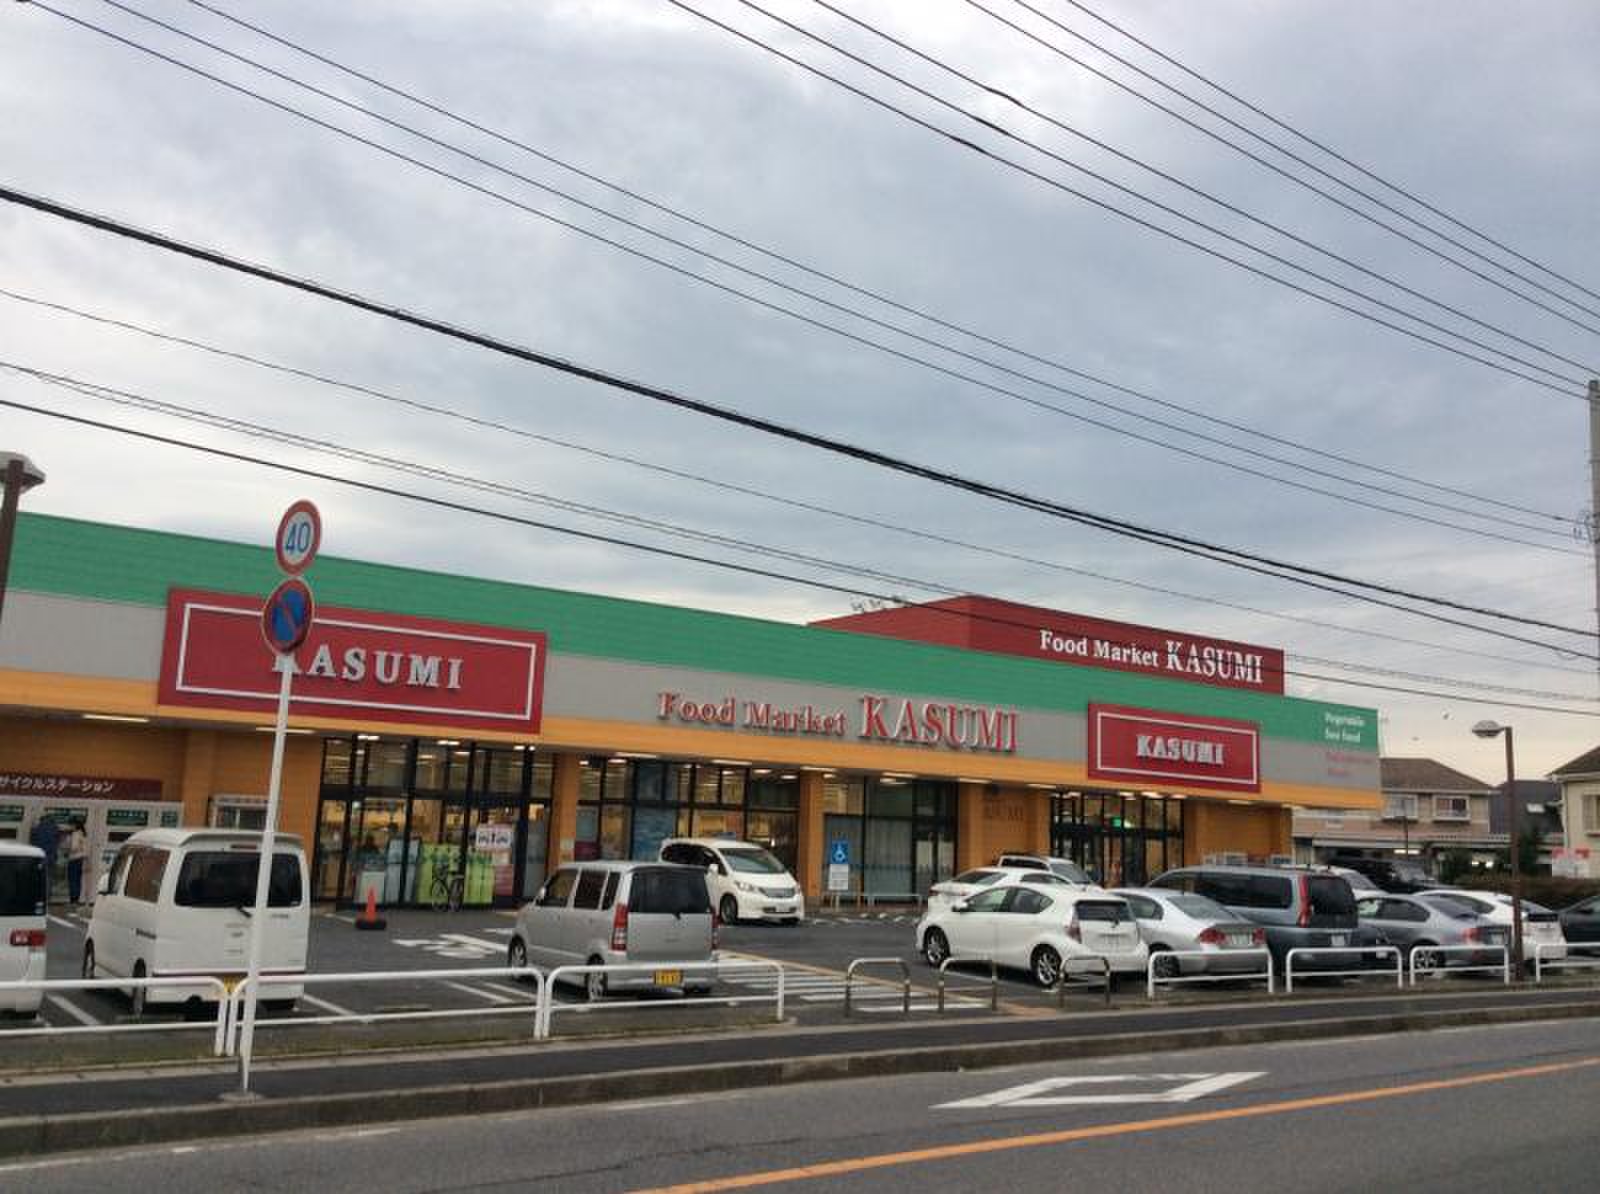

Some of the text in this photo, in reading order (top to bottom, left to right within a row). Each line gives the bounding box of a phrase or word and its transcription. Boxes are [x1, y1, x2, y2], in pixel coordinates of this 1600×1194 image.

[285, 521, 311, 554] 40
[1039, 629, 1263, 684] Food Market KASUMI
[657, 692, 1019, 753] Food Market KASUMI
[1136, 735, 1225, 766] KASUMI
